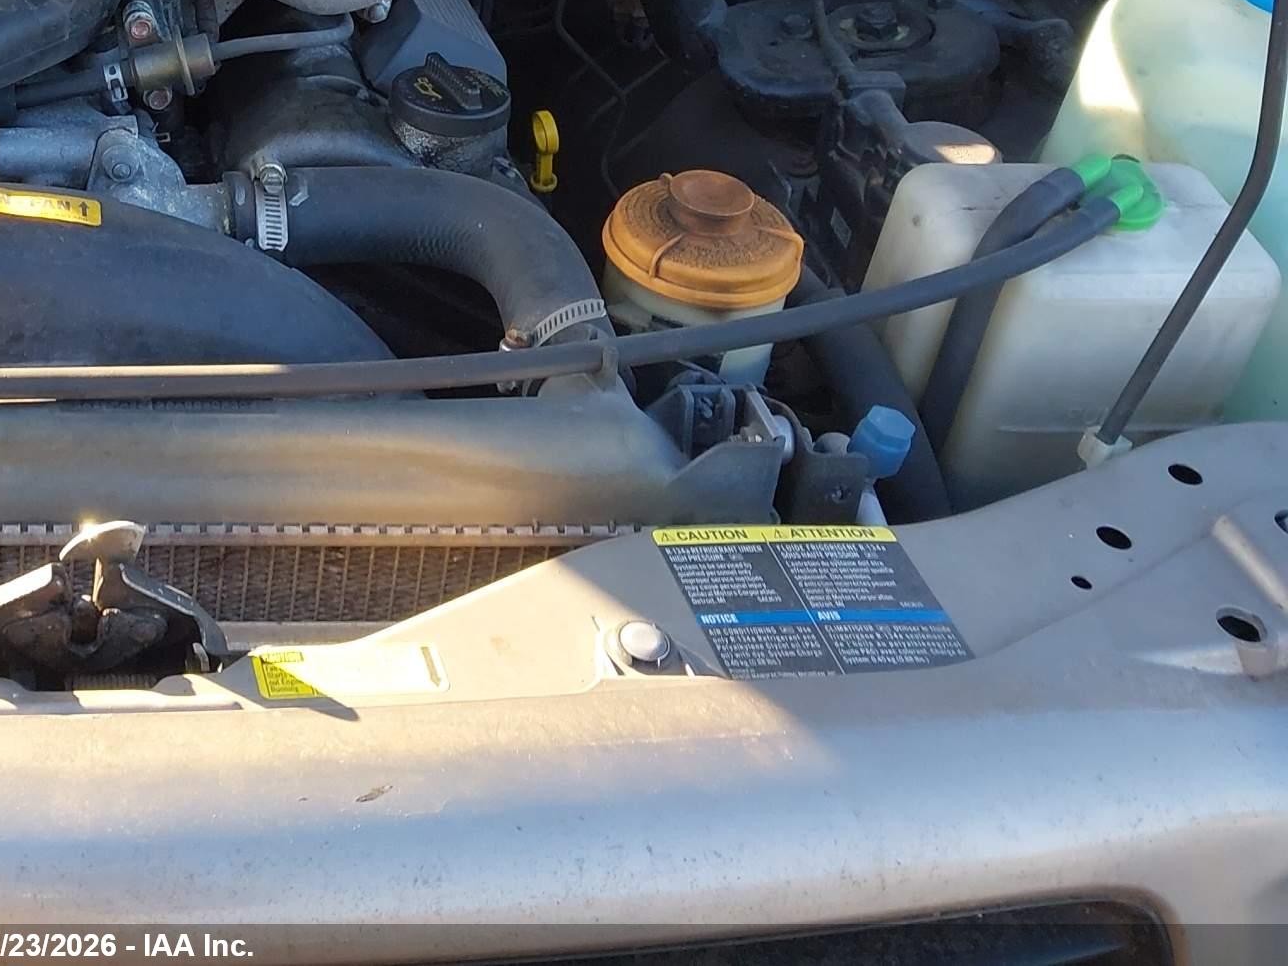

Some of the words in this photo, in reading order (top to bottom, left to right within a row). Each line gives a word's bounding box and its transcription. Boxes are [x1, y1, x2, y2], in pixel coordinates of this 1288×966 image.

[676, 530, 748, 541] CAUTION
[790, 528, 876, 538] ATTENTION
[690, 546, 737, 554] REFRIGERANT
[737, 545, 763, 553] UNDER
[832, 594, 855, 602] Motors
[700, 614, 739, 625] NOTICE
[817, 611, 841, 621] AVIS
[708, 628, 722, 636] AIR
[722, 626, 777, 635] CONDITIONING
[796, 626, 812, 634] Use
[713, 635, 729, 644] only
[757, 634, 801, 643] Refrigerant
